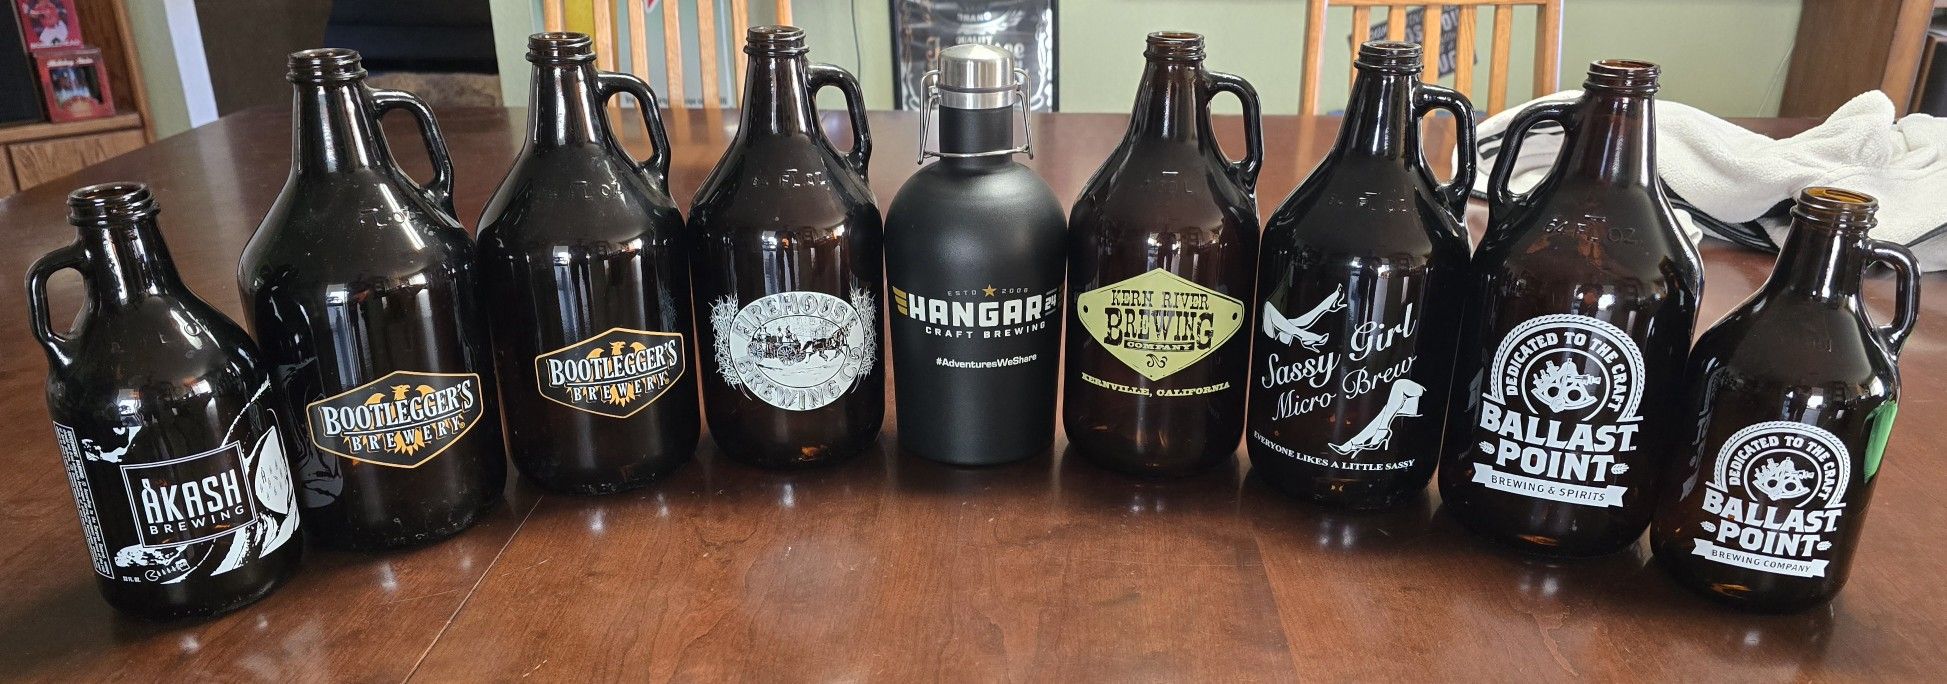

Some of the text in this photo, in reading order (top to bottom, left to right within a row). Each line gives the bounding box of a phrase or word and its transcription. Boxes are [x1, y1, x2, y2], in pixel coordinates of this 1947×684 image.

[908, 293, 1057, 328] HANGAR 24
[947, 289, 977, 297] ESTD
[1111, 289, 1210, 310] KERN RIVER
[925, 321, 1046, 339] CRAFT BREWING
[1103, 307, 1214, 350] BREWING
[1126, 341, 1193, 351] COMPANY
[1261, 302, 1417, 389] Sassy Girl
[547, 339, 678, 386] BOOTLEGGER'S
[936, 353, 1037, 369] #AdventuresWeShare
[1506, 331, 1628, 413] DEDICATED TO THE CRAFT
[571, 372, 667, 402] BREWERY
[1081, 371, 1231, 398] KERNVILLE, CALIFORNIA
[1272, 355, 1418, 421] Micro Brew
[319, 379, 474, 436] BOOTLEGGER'S
[351, 417, 461, 452] BREWERY
[1479, 400, 1639, 452] BALLAST
[1253, 430, 1416, 471] EVERYONE LIKES A LITTLE SASSY
[1496, 437, 1615, 482] POINT
[1728, 435, 1837, 500] DEDICATED TO THE CRAFT
[1491, 474, 1606, 501] BREWING & SPIRITS
[149, 504, 245, 535] BREWING
[1701, 487, 1842, 533] BALLAST
[1716, 519, 1820, 557] POINT
[1711, 549, 1811, 573] BREWING COMPANY
